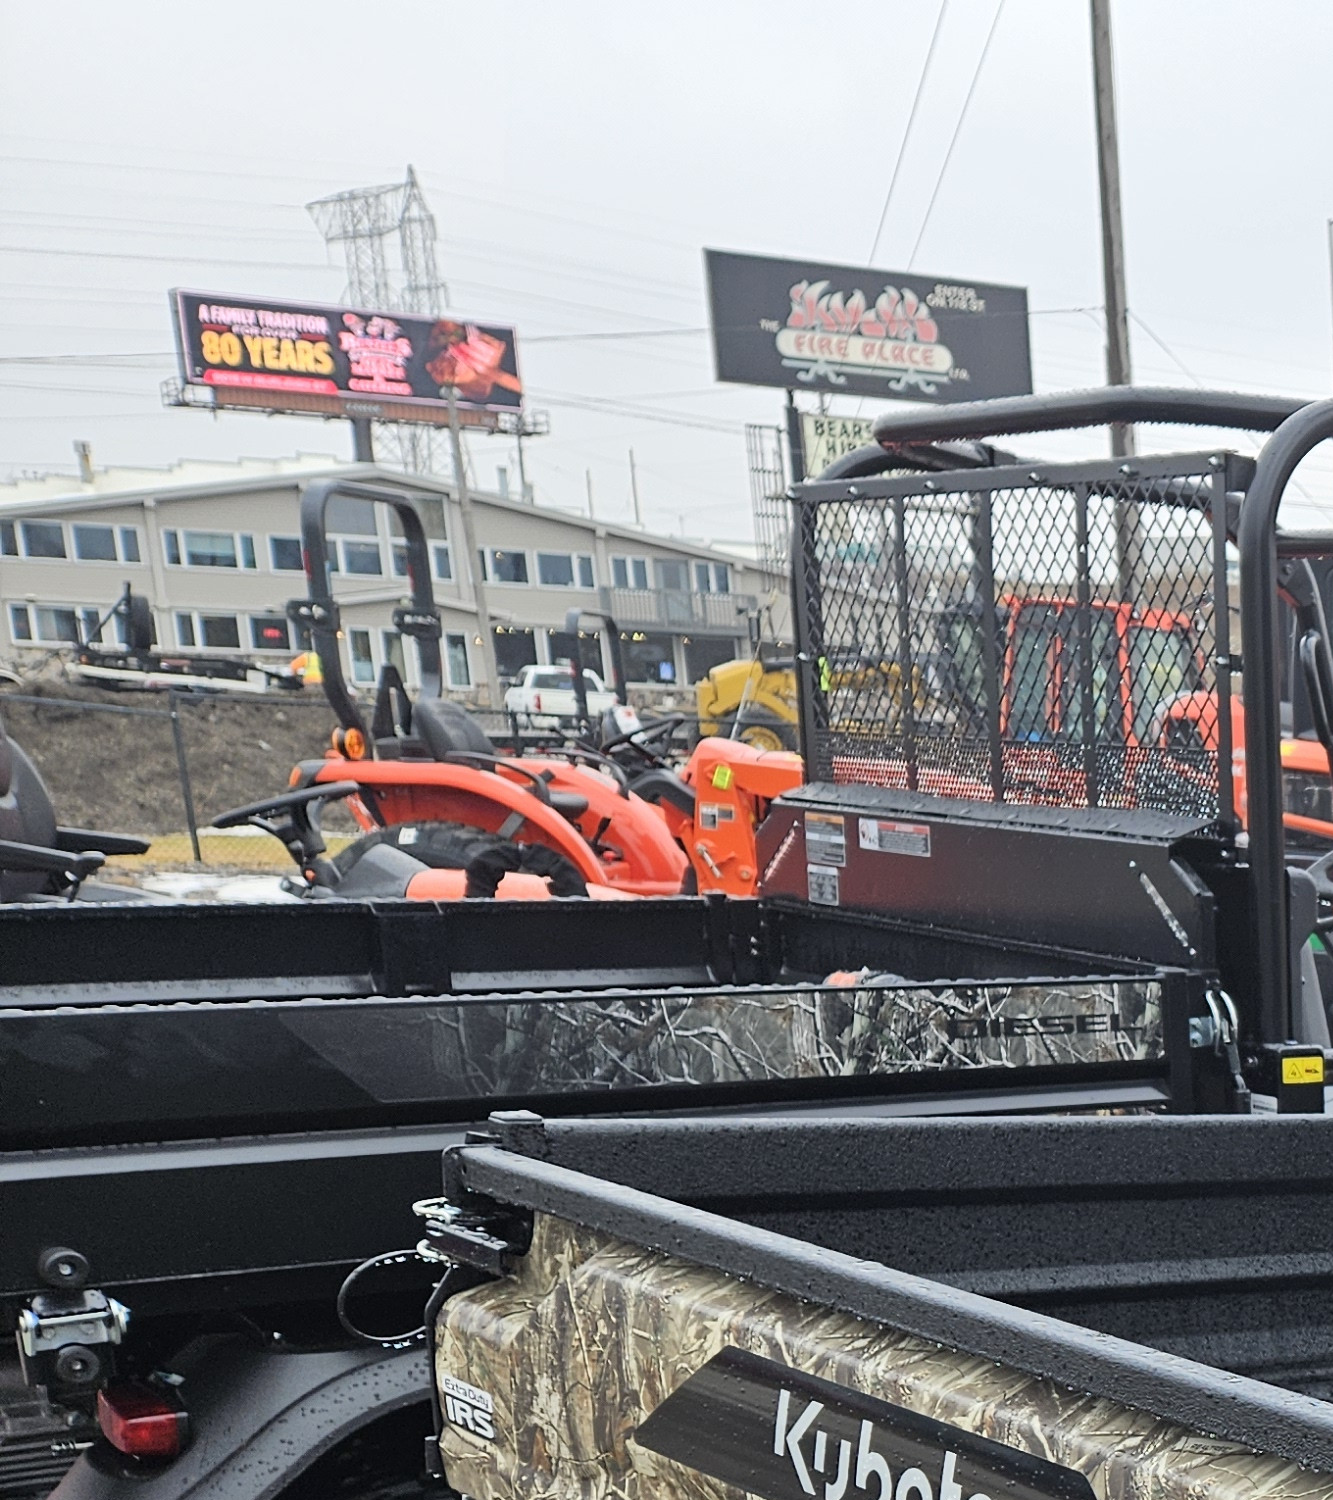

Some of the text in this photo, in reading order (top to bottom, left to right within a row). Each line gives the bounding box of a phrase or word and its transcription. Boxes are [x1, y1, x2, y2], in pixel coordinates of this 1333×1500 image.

[198, 303, 329, 335] A FAMILY TRADITION
[759, 318, 779, 333] THE
[201, 330, 242, 366] 80
[243, 334, 335, 375] YEARS
[794, 333, 936, 366] FIRE PLACE
[949, 1013, 1144, 1041] DIESEL
[445, 1394, 495, 1439] IRS
